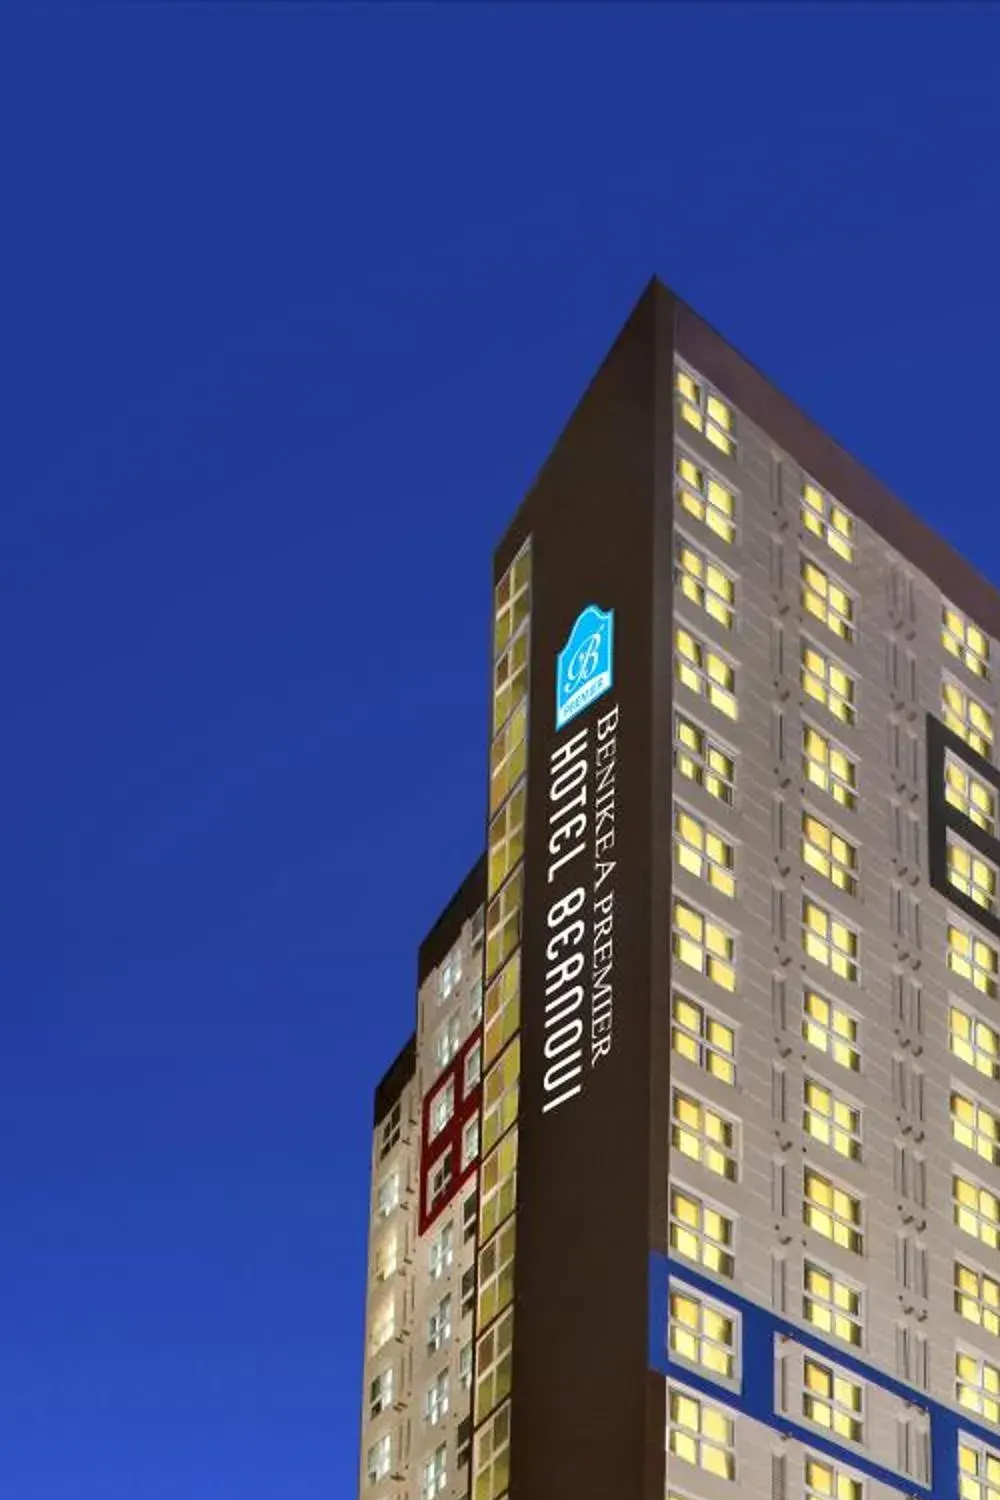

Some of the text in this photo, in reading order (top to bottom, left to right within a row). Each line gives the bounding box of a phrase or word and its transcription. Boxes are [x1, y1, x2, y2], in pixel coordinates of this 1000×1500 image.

[542, 728, 588, 1114] HOTEL BERNOUI
[591, 704, 619, 1068] BENIKEA PREMIER
